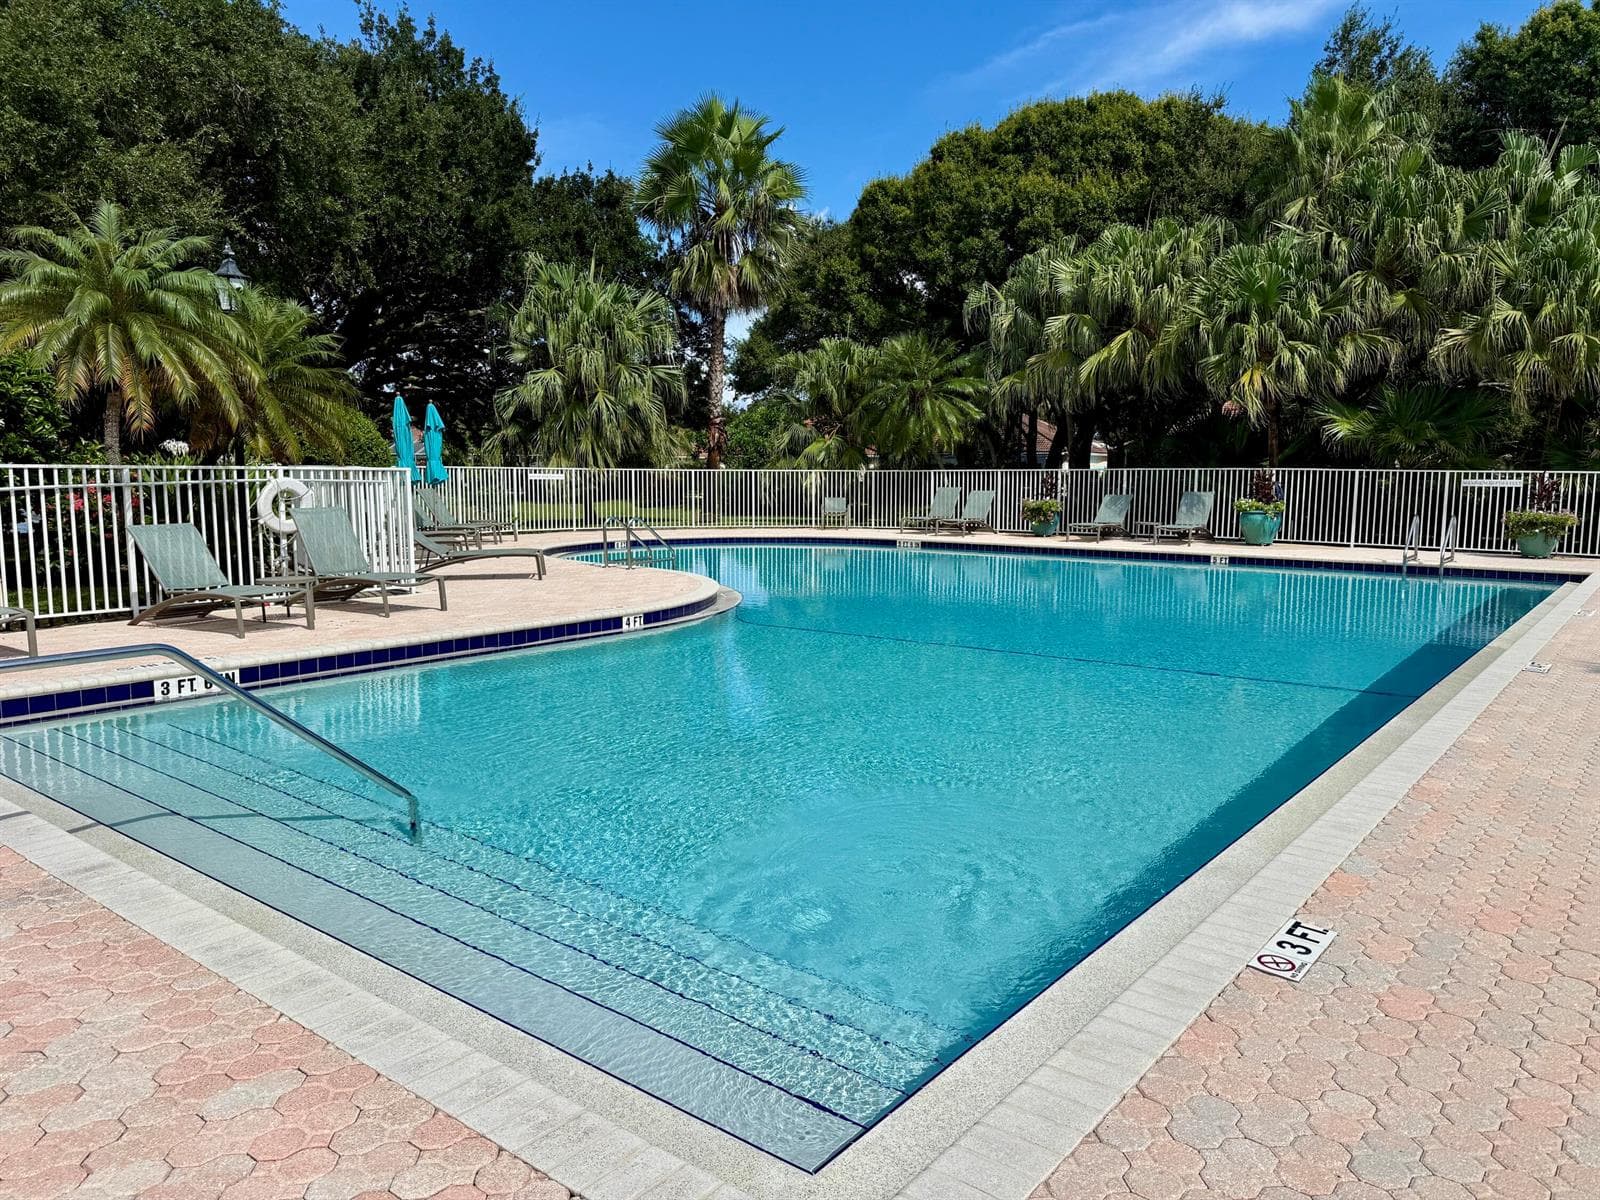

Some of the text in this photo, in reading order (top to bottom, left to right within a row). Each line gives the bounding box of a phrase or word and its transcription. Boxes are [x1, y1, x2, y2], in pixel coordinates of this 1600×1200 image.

[625, 615, 643, 629] 4 FT
[160, 681, 171, 696] 3
[177, 677, 198, 694] FT.
[1276, 920, 1330, 955] 3 FT.
